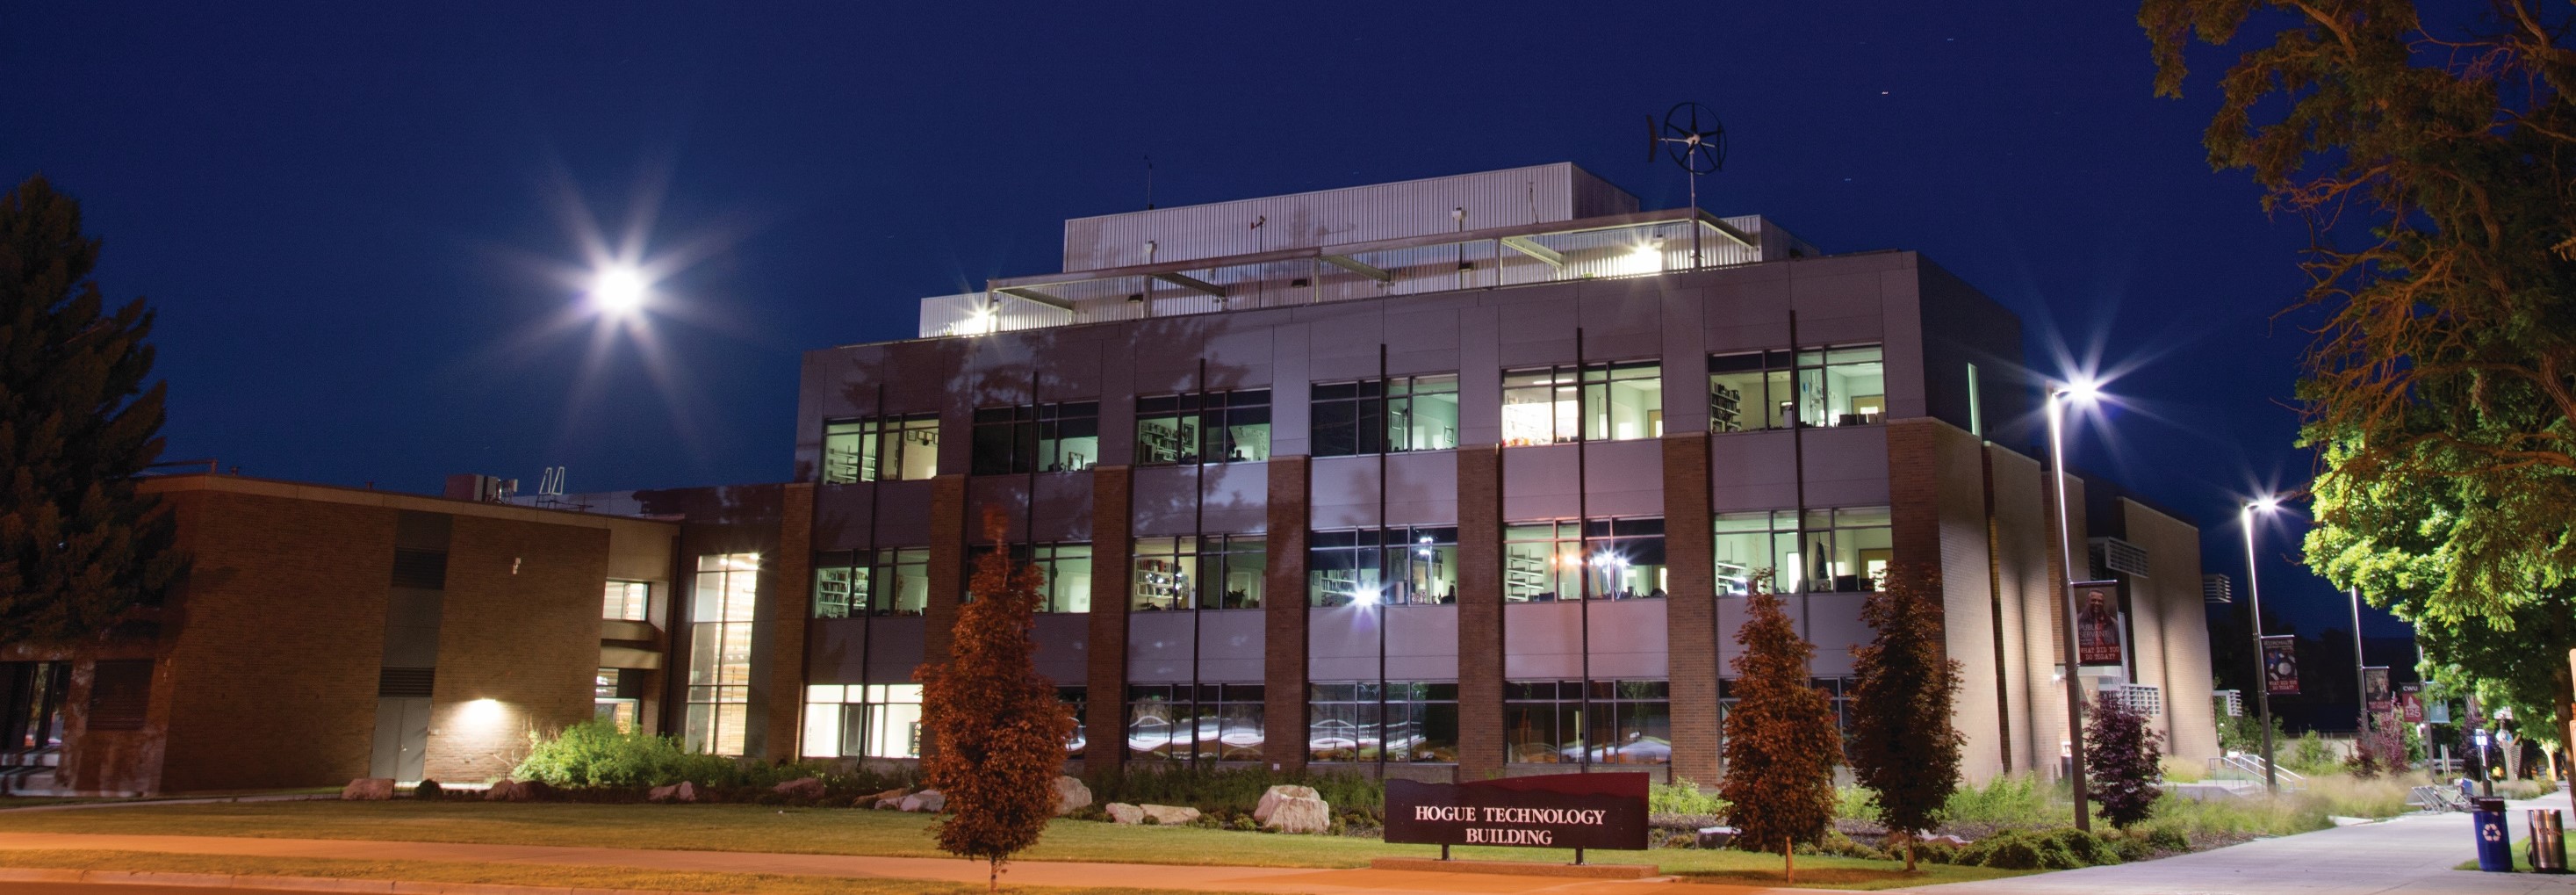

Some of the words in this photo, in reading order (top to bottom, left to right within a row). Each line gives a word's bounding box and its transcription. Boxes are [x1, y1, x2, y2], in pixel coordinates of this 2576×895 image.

[2406, 709, 2421, 718] 125
[1414, 805, 1476, 821] HOGUE
[1483, 806, 1606, 825] TECHNOLOGY
[1465, 828, 1552, 845] BUILDING
